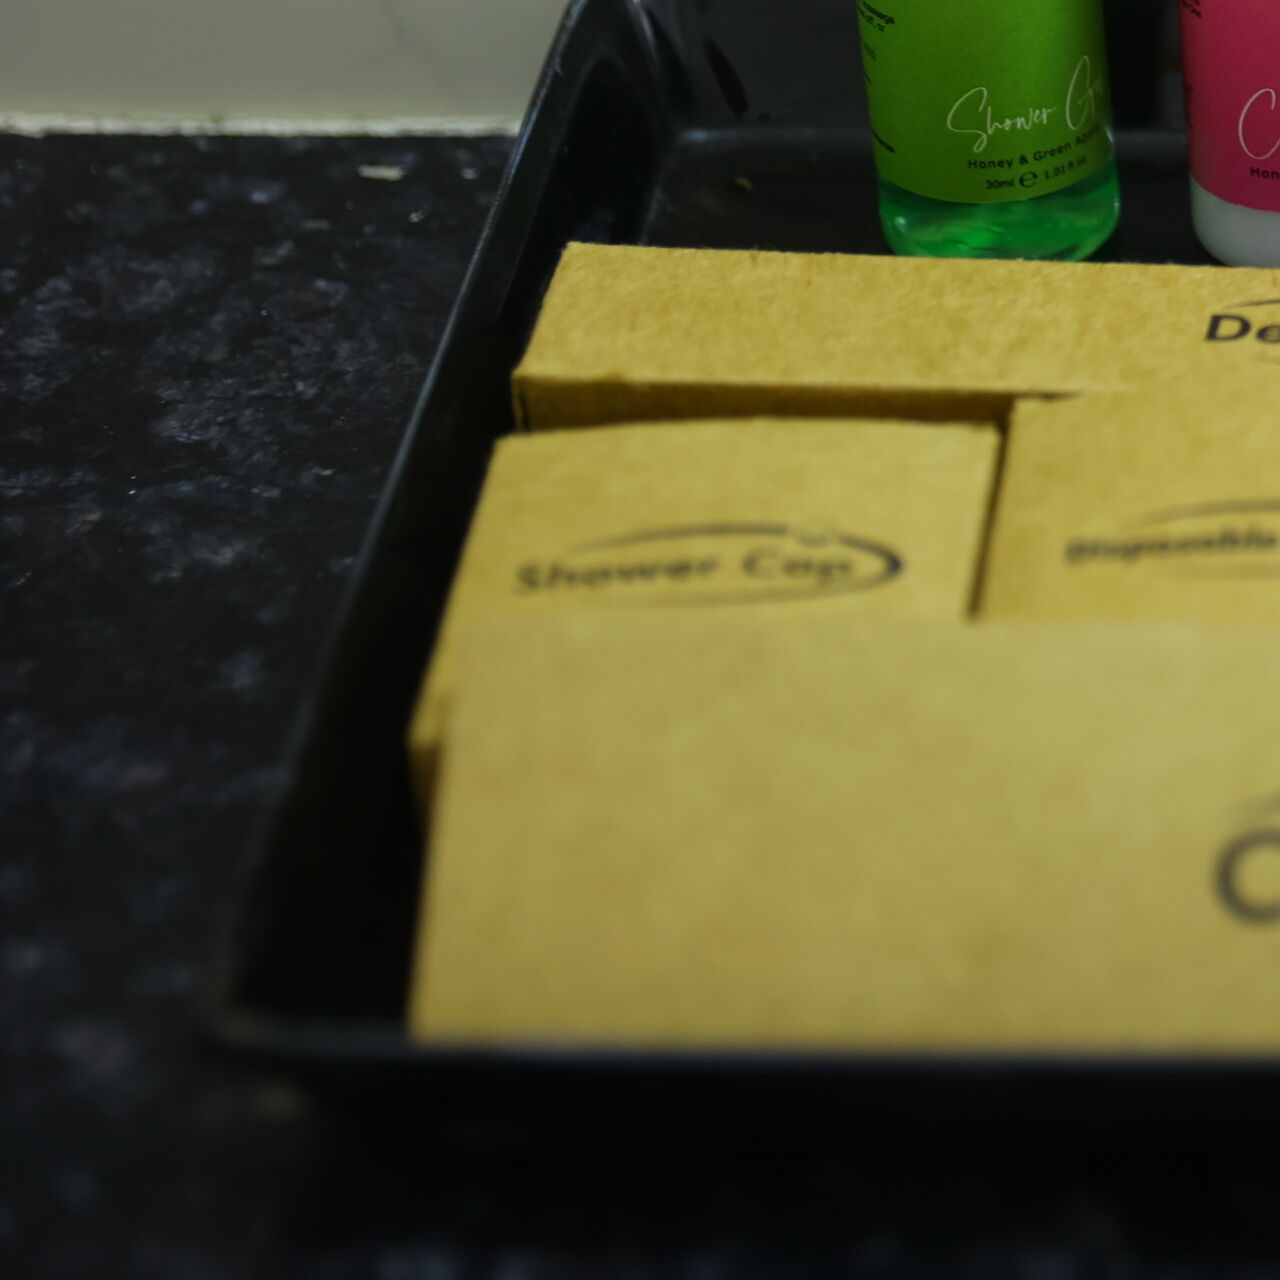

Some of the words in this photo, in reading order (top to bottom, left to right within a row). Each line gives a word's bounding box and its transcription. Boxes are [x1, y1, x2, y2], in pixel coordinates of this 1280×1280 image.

[946, 87, 1055, 152] Shower
[967, 157, 1014, 170] Honey
[1018, 154, 1029, 165] &
[1033, 142, 1072, 162] Green
[513, 554, 720, 592] Shower
[740, 547, 854, 587] Cap
